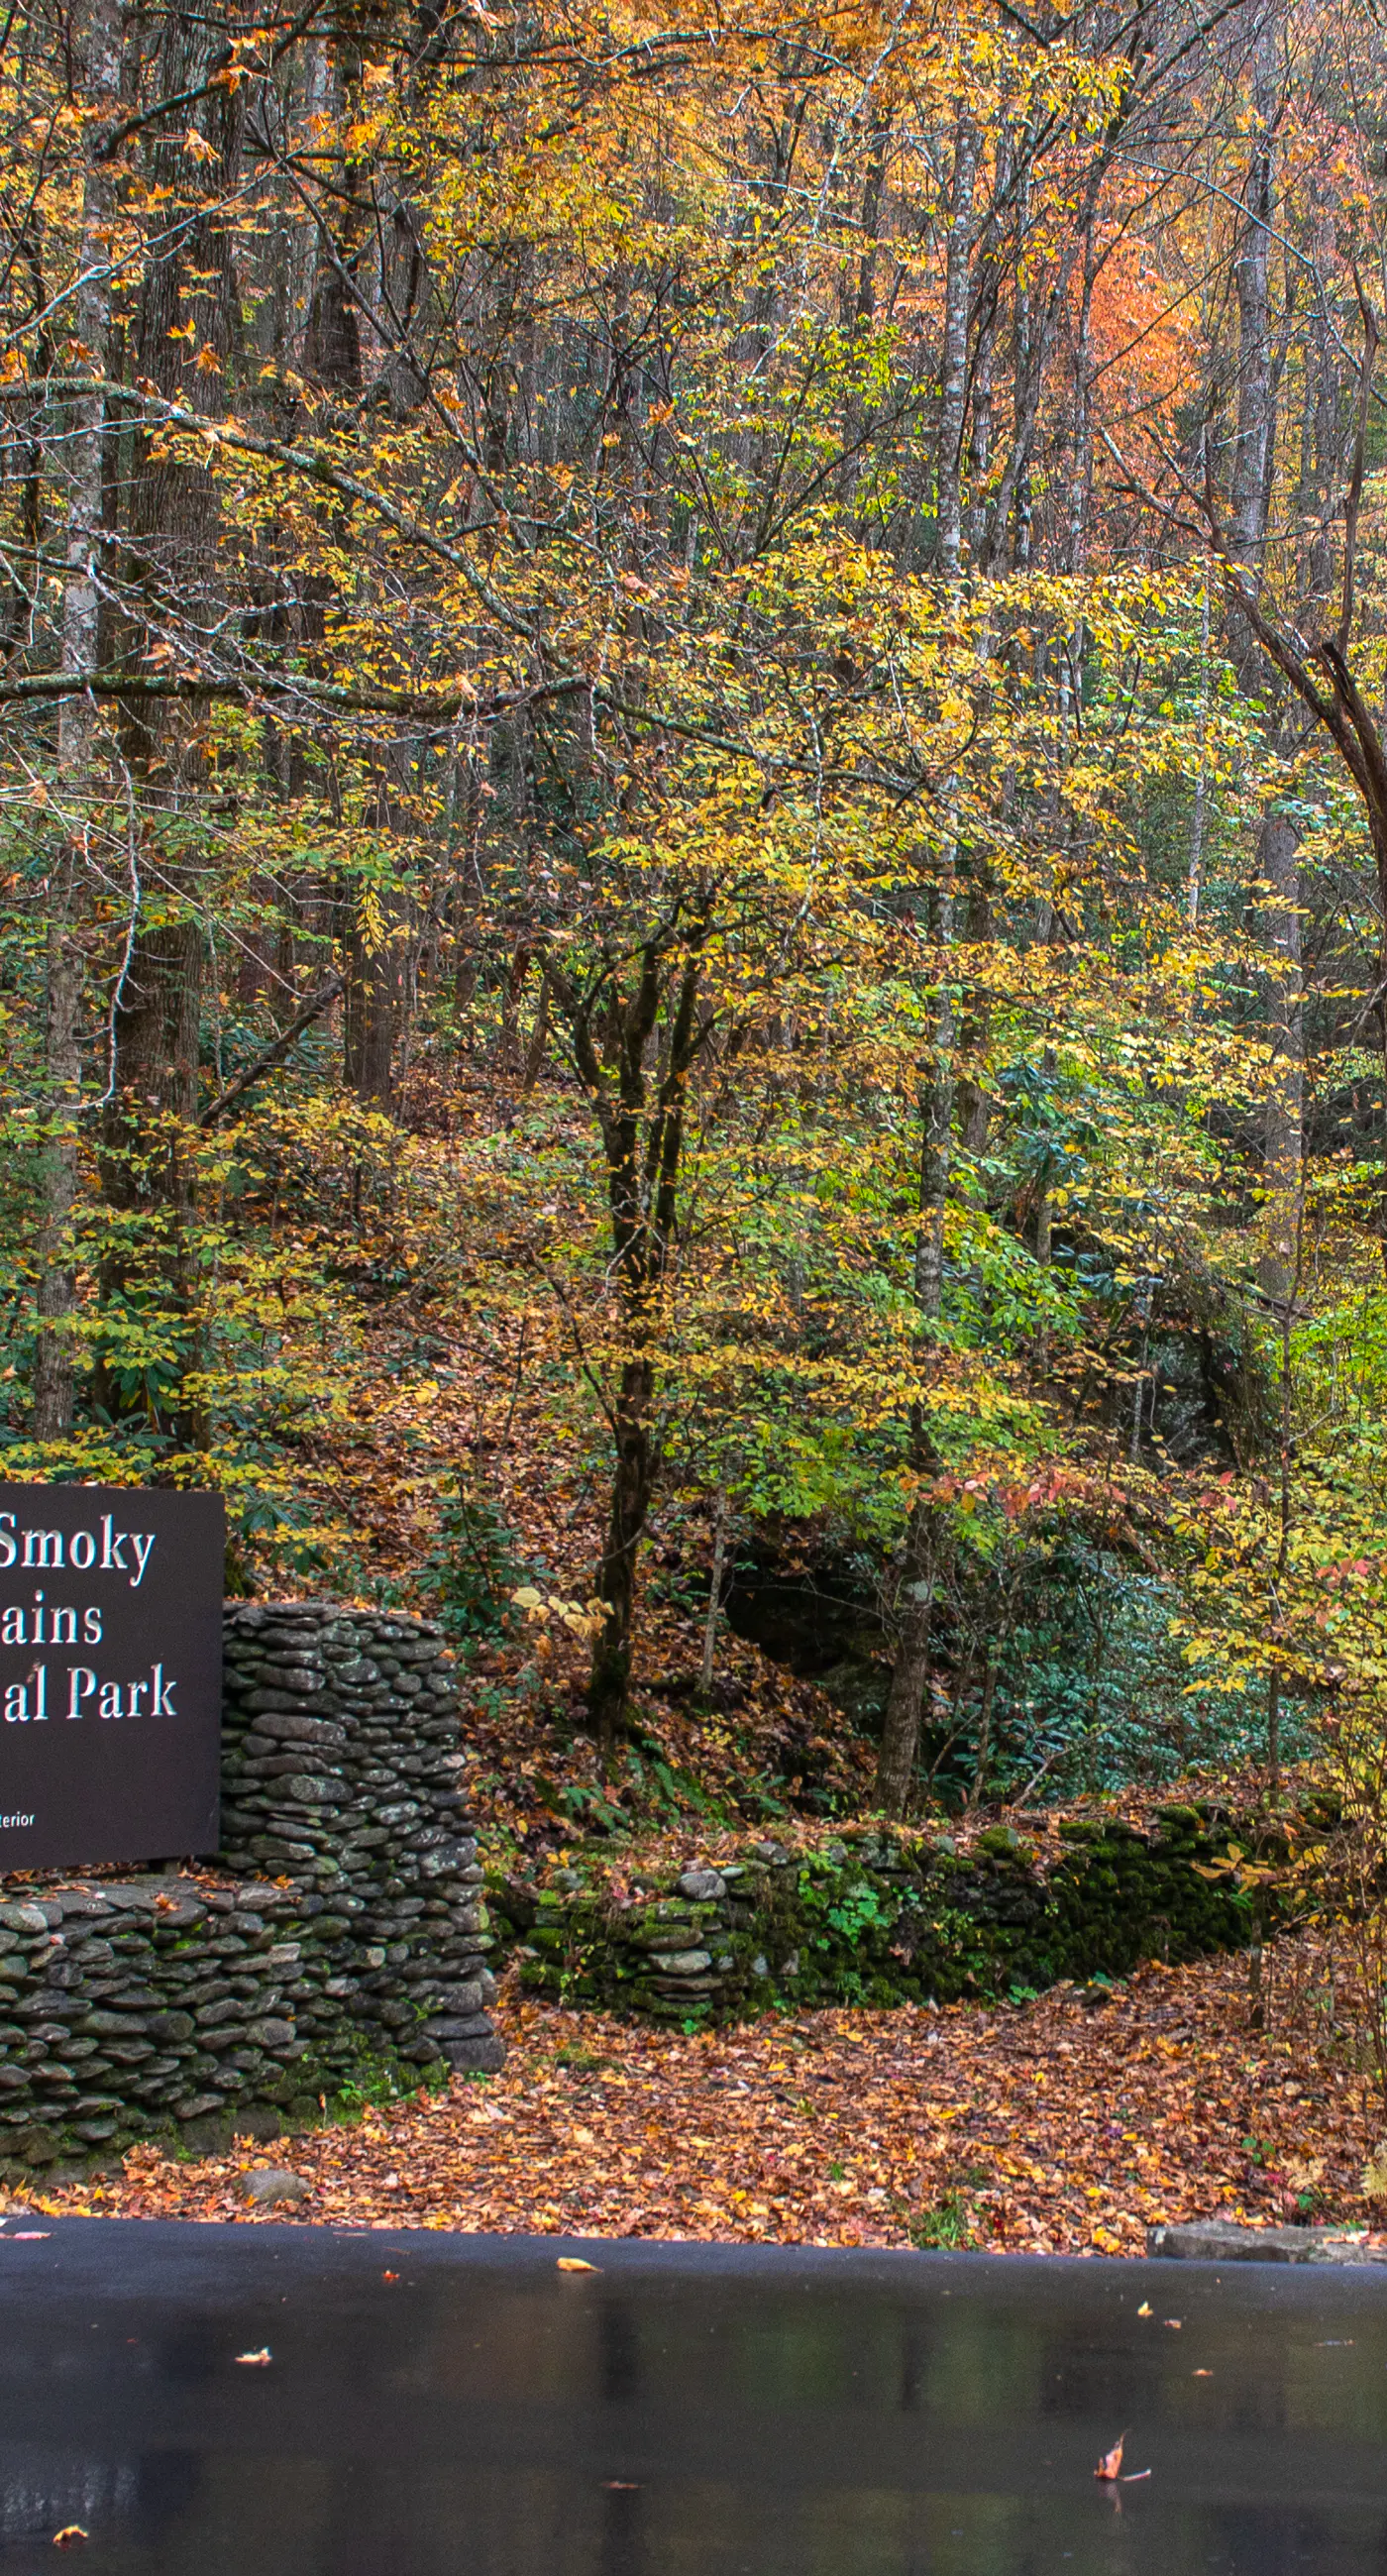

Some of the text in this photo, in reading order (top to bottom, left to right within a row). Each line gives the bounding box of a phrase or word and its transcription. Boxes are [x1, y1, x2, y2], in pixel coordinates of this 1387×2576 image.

[0, 1511, 156, 1586] Smoky
[2, 1589, 103, 1645] ains
[4, 1663, 177, 1722] al Park
